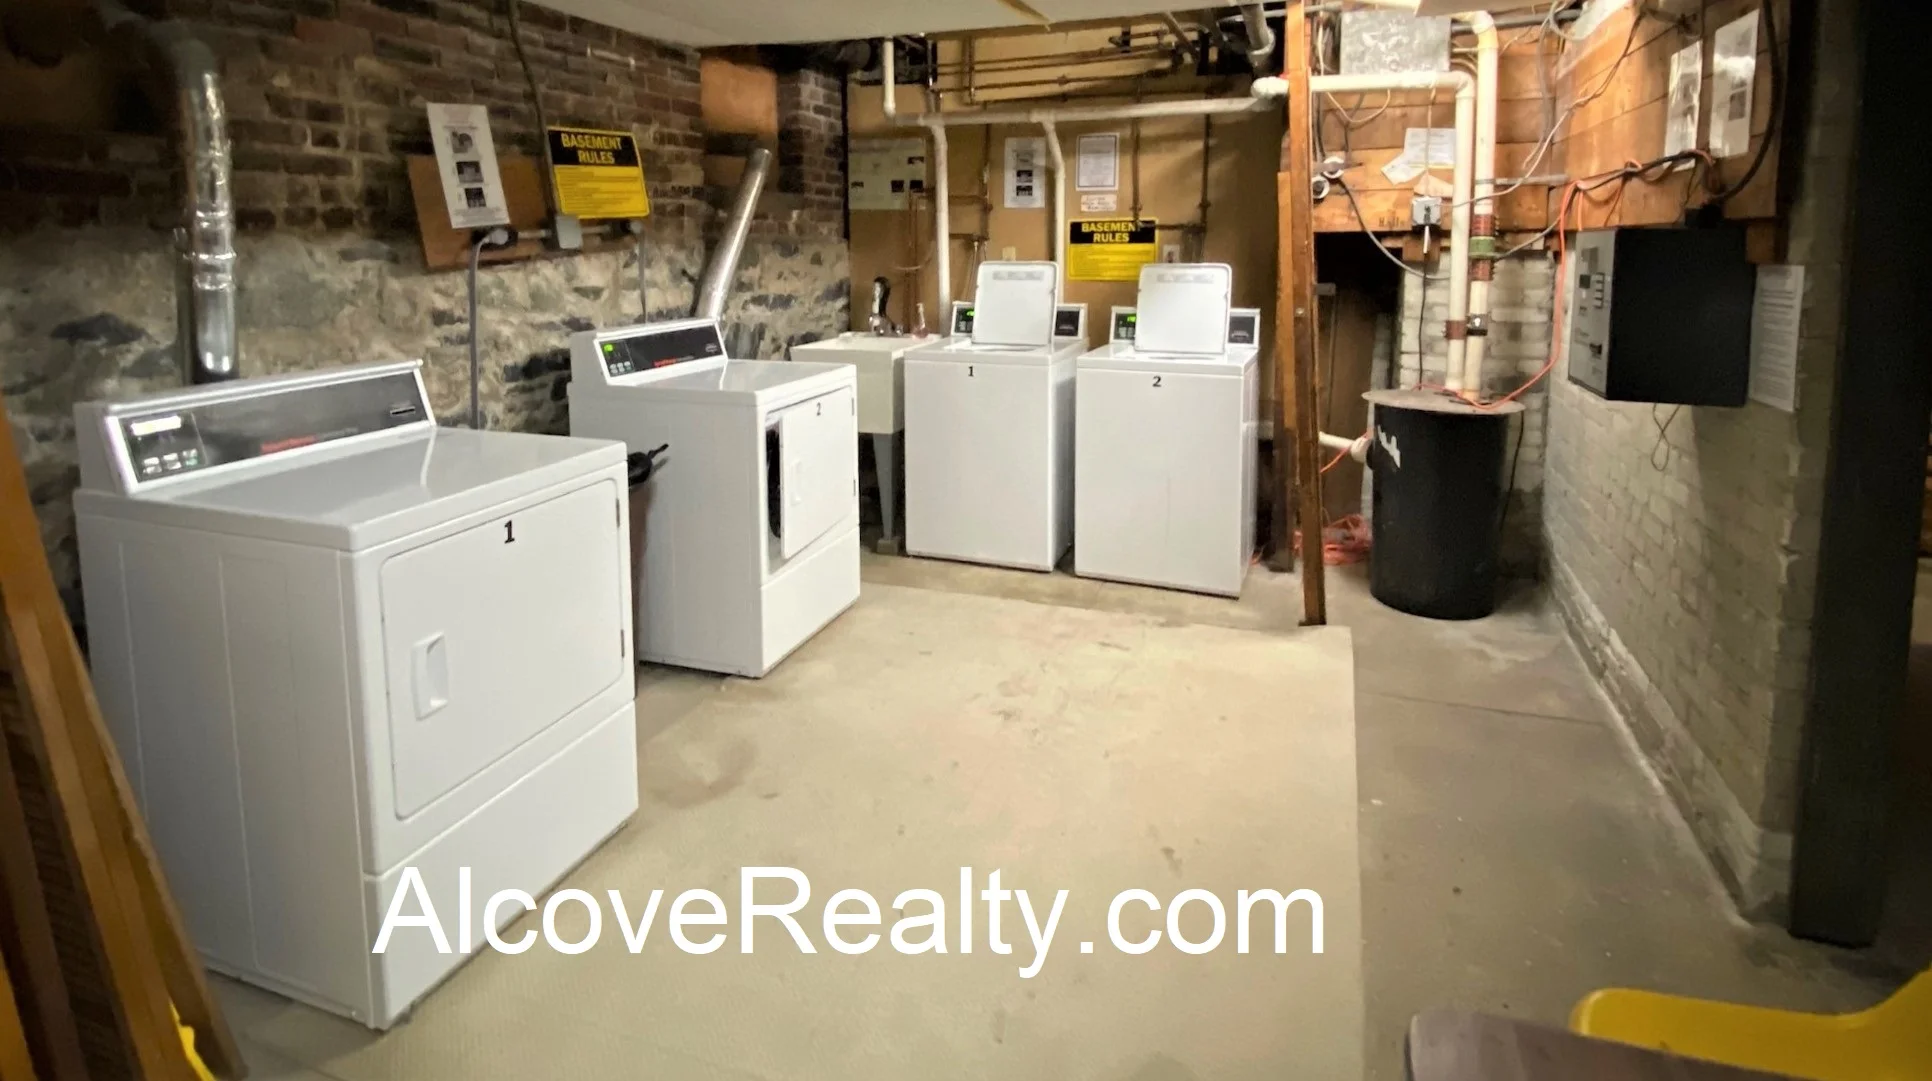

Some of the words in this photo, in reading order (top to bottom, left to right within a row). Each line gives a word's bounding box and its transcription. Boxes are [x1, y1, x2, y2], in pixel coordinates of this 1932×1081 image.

[561, 133, 622, 150] BASEMENT
[577, 150, 615, 164] RULES
[1093, 232, 1130, 243] RULES
[968, 366, 974, 377] 1
[1152, 375, 1162, 388] 2
[816, 402, 822, 416] 2
[504, 520, 515, 544] 1
